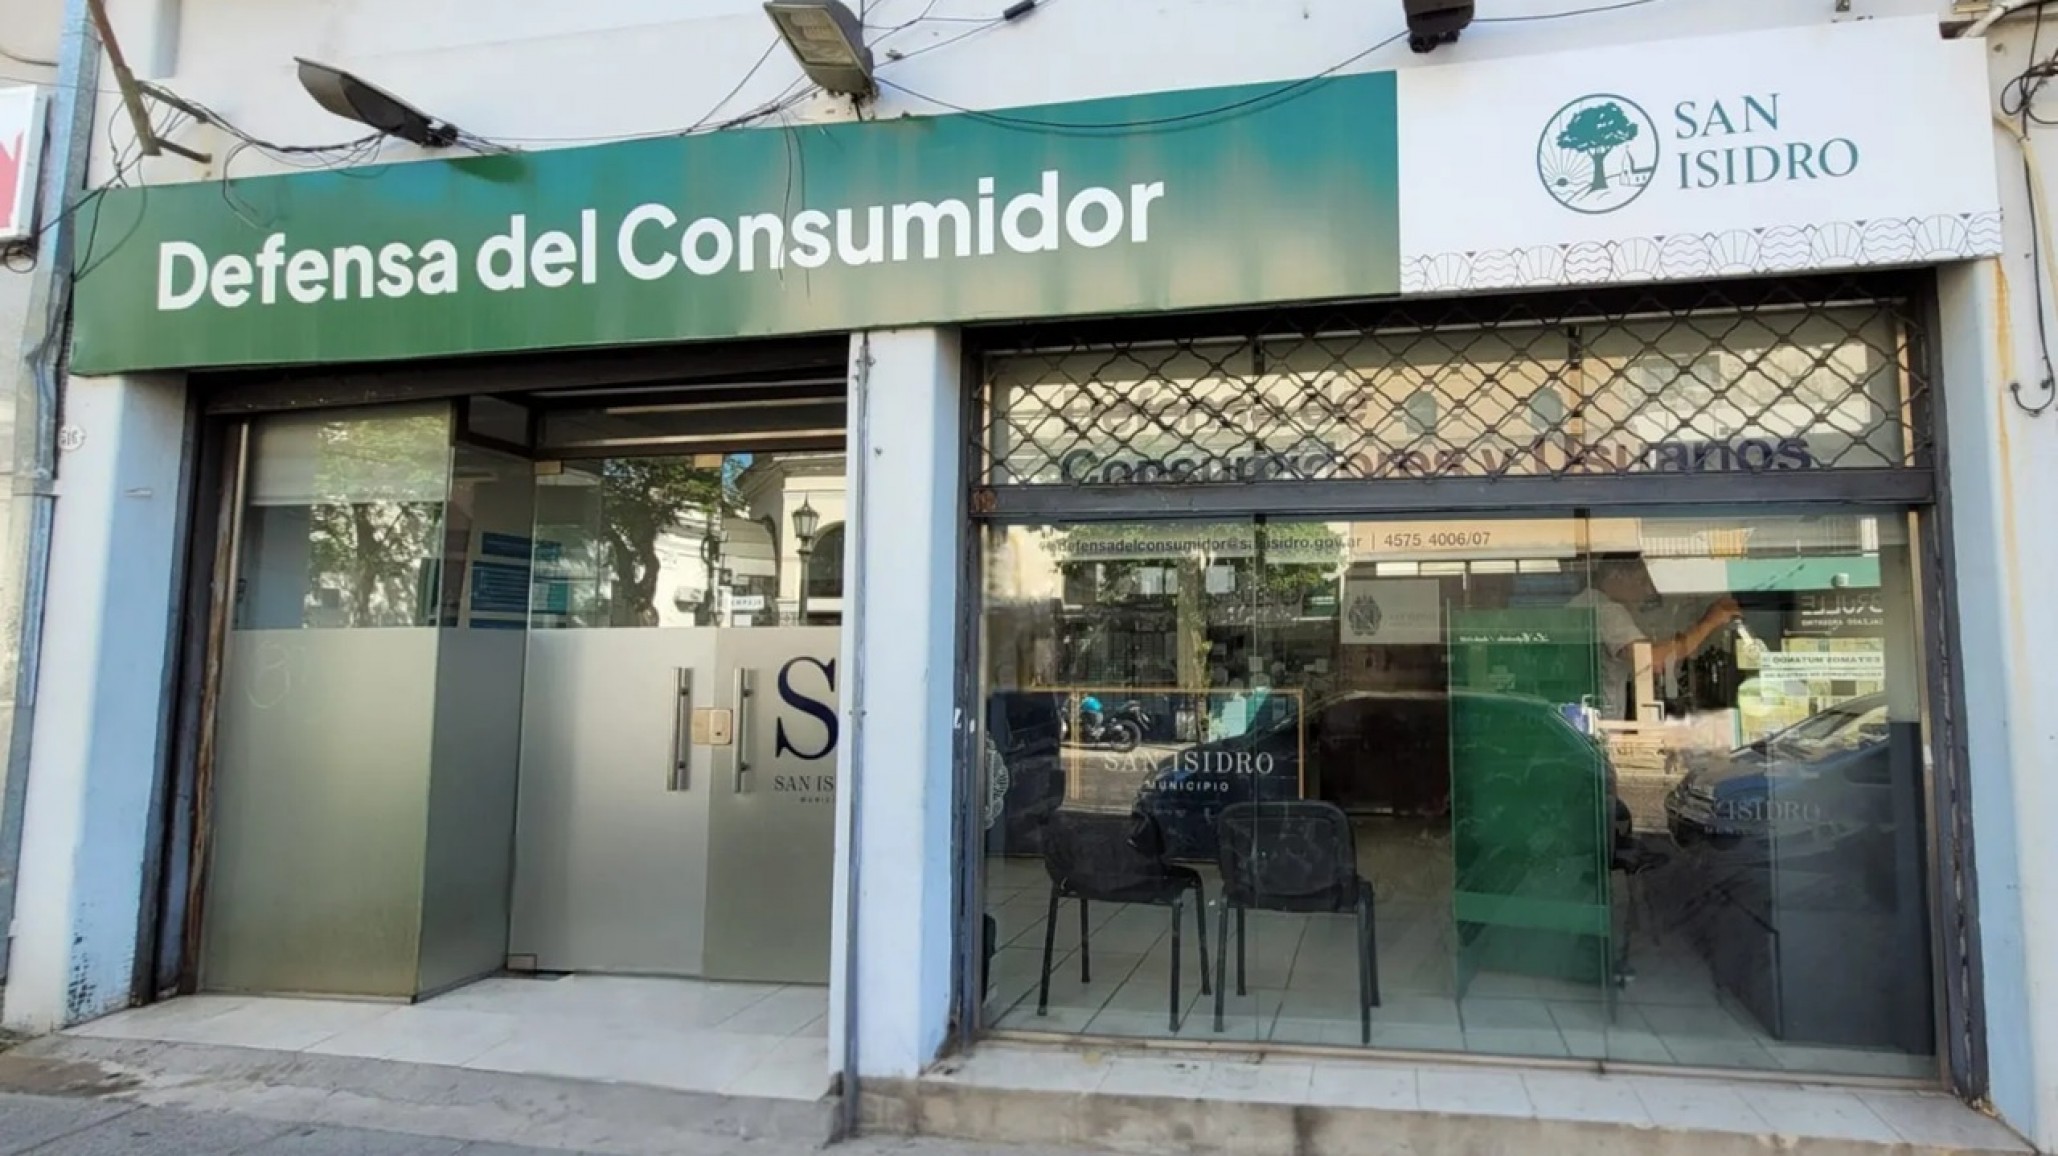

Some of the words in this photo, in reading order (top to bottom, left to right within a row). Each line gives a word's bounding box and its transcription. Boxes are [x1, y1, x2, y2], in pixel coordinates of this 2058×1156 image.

[1675, 93, 1780, 141] SAN
[1676, 137, 1859, 190] ISIDRO
[156, 231, 459, 312] Defensa
[475, 208, 597, 292] del
[616, 169, 1165, 281] Consumidor
[1384, 532, 1422, 548] 4575
[1429, 531, 1492, 547] 4006/07
[774, 655, 839, 761] S
[774, 775, 811, 792] SAN
[1103, 750, 1159, 772] SAN
[1172, 751, 1274, 775] ISIDRO
